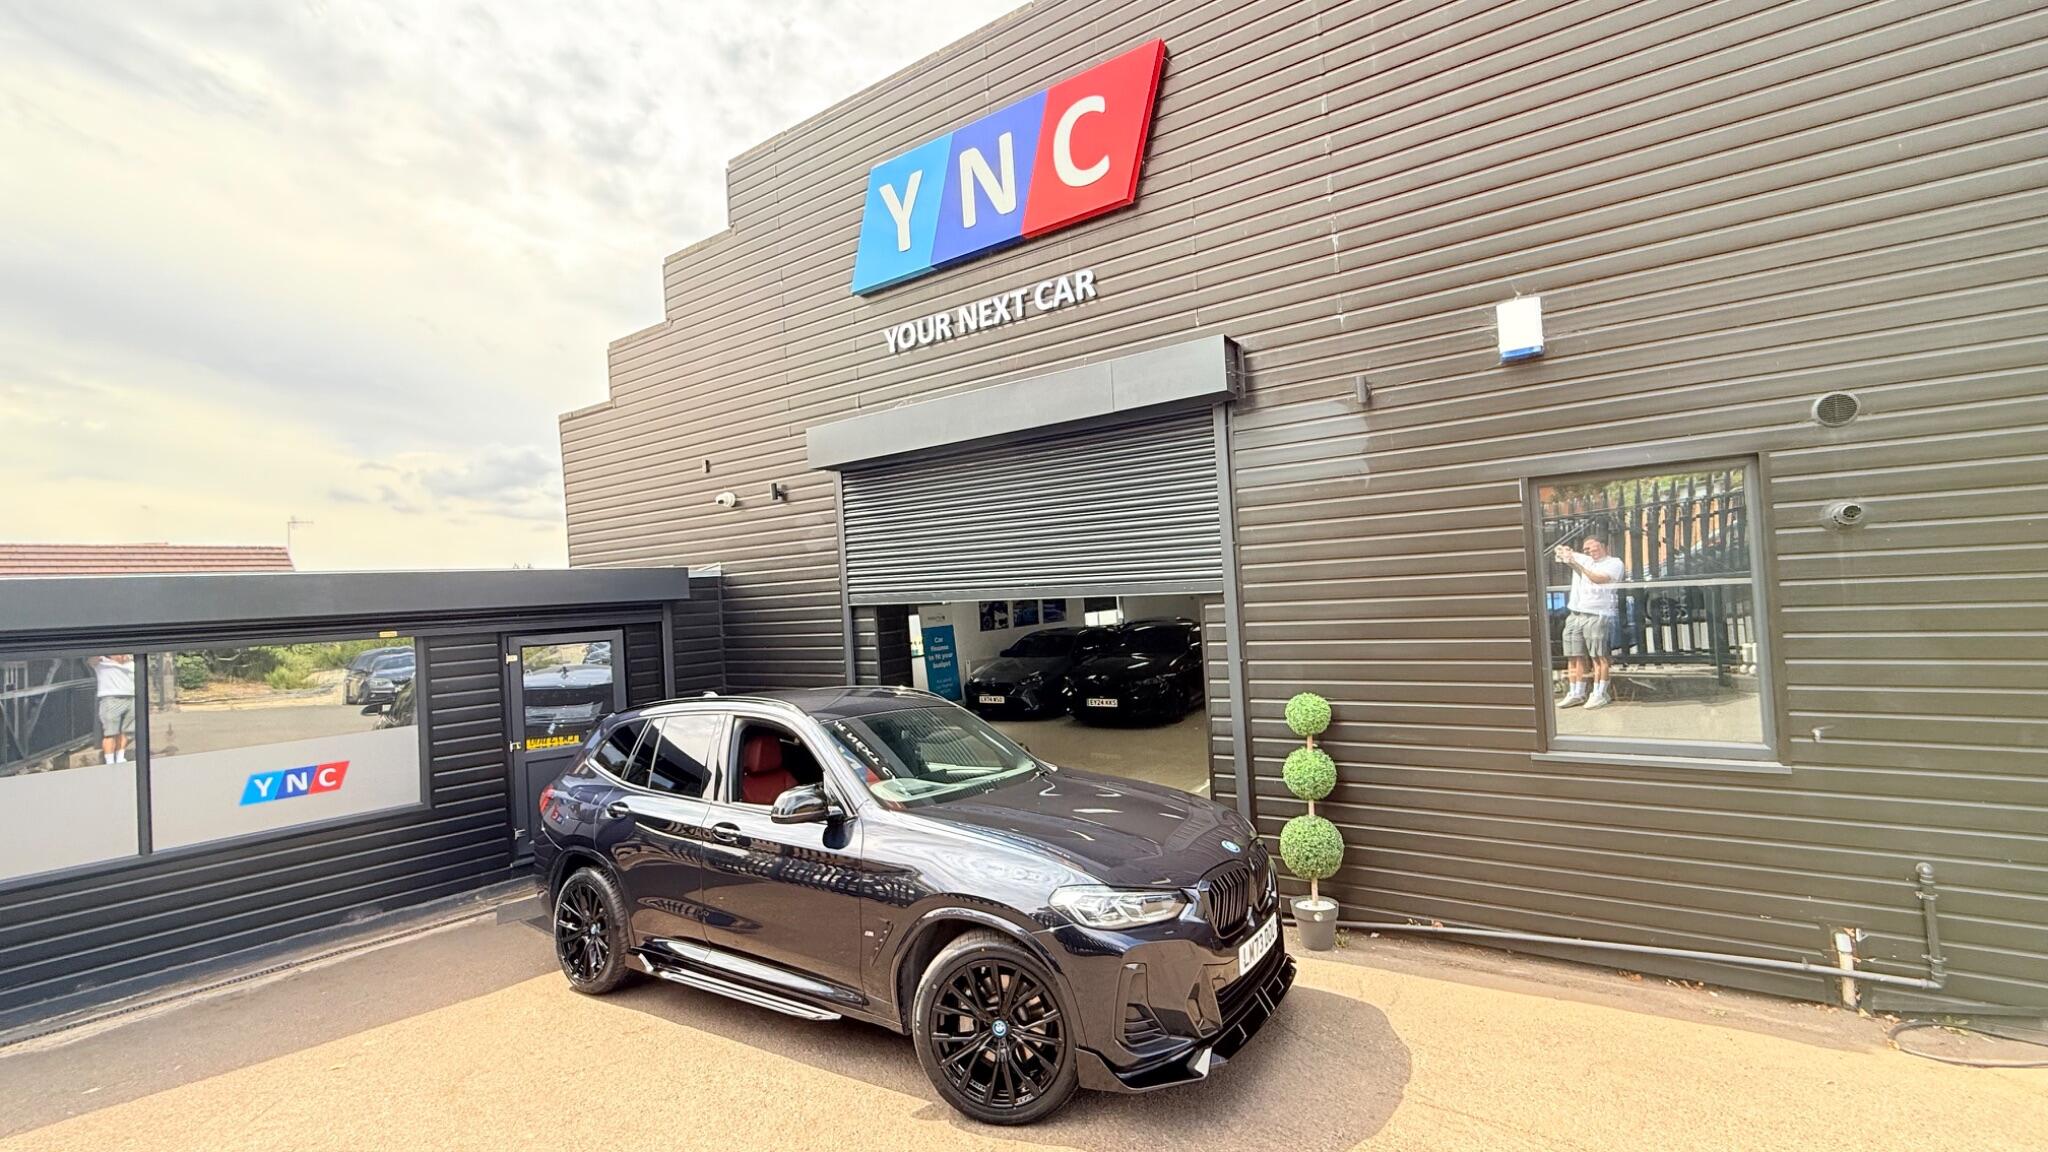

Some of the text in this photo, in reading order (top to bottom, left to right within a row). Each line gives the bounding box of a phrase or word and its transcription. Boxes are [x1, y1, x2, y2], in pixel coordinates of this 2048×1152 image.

[879, 95, 1110, 252] YNC
[884, 269, 1097, 354] YOUR NEXT CAR
[254, 767, 337, 798] YNC
